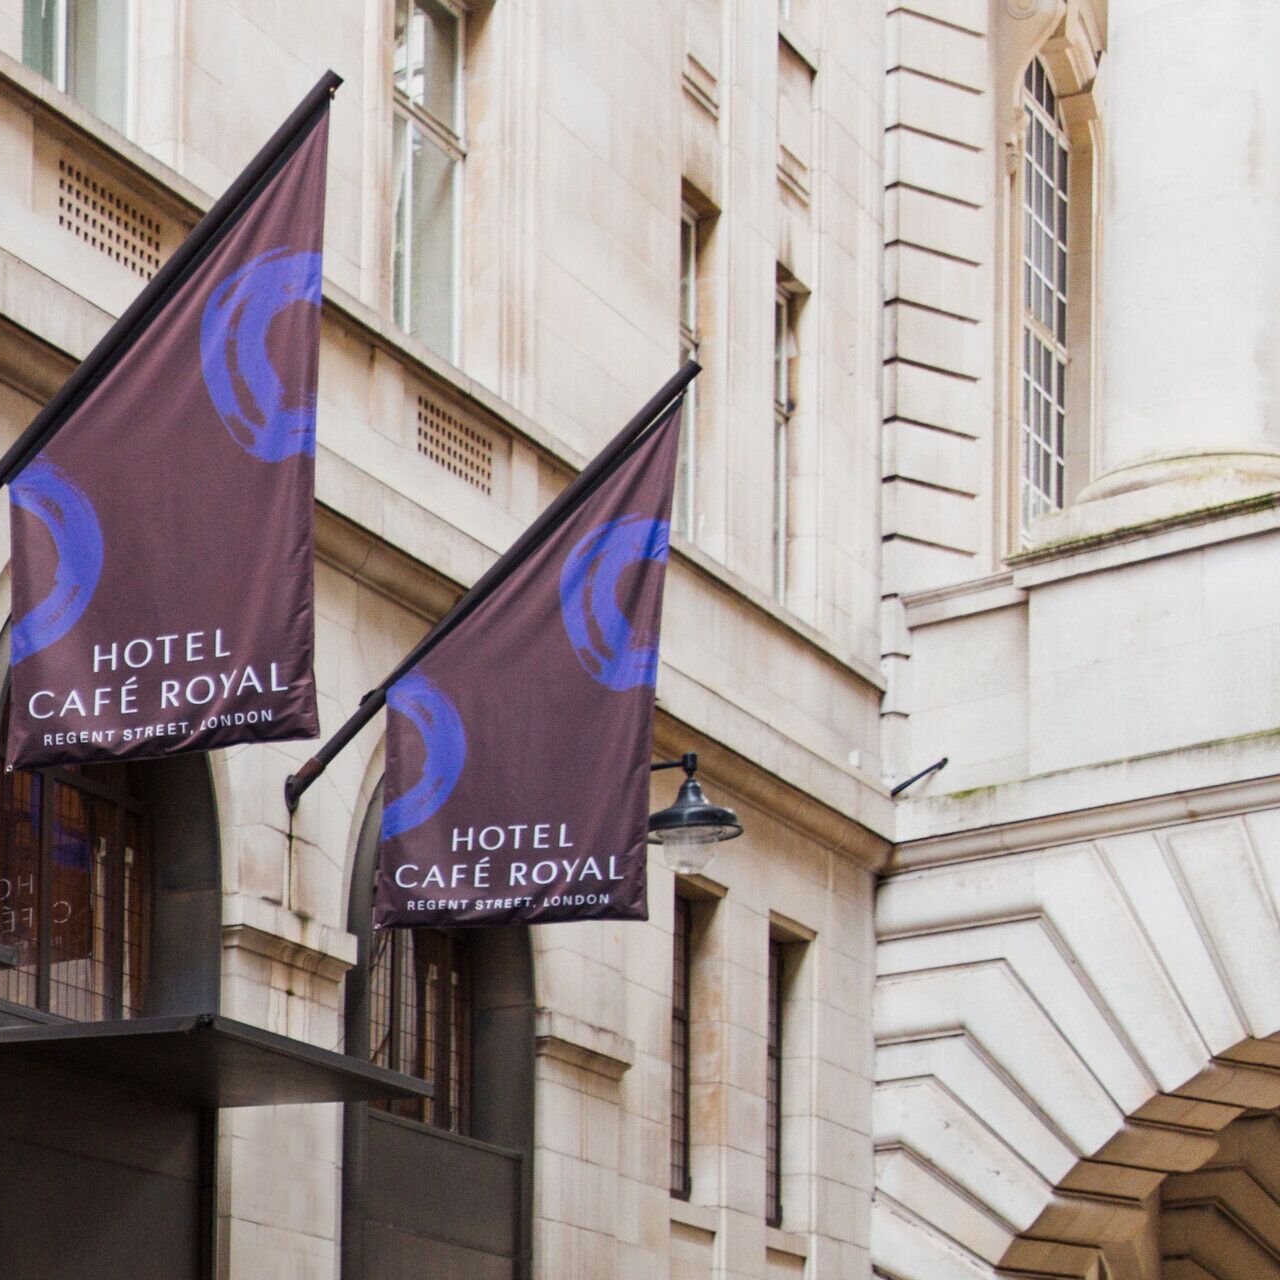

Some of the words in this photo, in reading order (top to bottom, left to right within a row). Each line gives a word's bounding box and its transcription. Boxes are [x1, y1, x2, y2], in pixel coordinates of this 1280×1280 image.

[93, 628, 231, 673] HOTEL
[28, 676, 138, 719] CAFÉ
[161, 662, 289, 709] ROYAL
[43, 730, 116, 746] REGENT
[123, 721, 194, 741] STREET,
[452, 823, 574, 852] HOTEL
[395, 857, 490, 888] CAFÉ
[509, 855, 625, 886] ROYAL
[407, 900, 468, 911] REGENT
[475, 897, 537, 910] STREET,
[543, 894, 610, 908] LONDON
